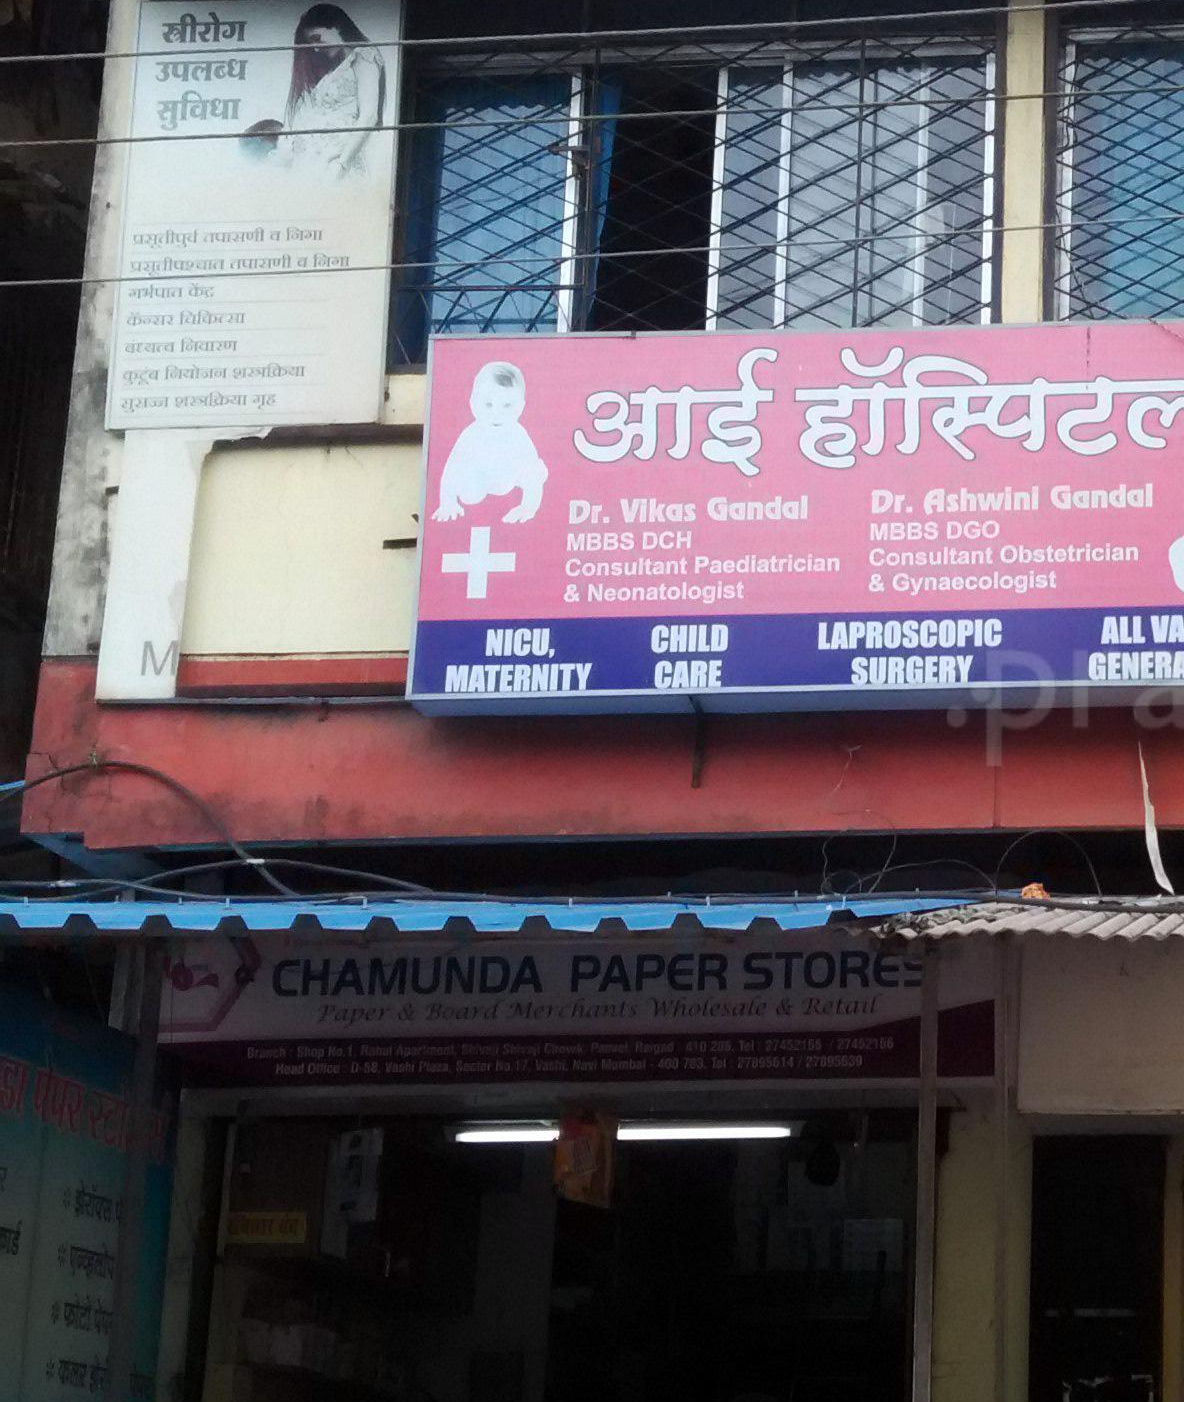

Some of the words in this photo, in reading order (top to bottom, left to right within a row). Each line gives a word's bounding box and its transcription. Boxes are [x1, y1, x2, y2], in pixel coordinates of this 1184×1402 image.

[162, 12, 247, 44] स्त्रीरोग
[156, 58, 248, 82] उपलब्ध
[157, 90, 241, 131] सुविधा
[165, 364, 227, 381] नियोजन
[573, 346, 778, 477] आई
[568, 499, 610, 525] Dr.
[620, 498, 696, 524] Vikas
[707, 495, 809, 521] Gandal
[871, 489, 913, 515] Dr.
[923, 485, 1039, 513] Ashwini
[1050, 483, 1154, 510] Gandal
[567, 531, 635, 552] MBBS
[642, 530, 692, 550] DCH
[869, 520, 939, 541] MBBS
[946, 519, 1001, 540] DGO
[565, 556, 688, 578] Consultant
[694, 554, 841, 575] Paediatrician
[868, 545, 993, 567] Consultant
[1000, 542, 1140, 565] Obstetrician
[563, 582, 580, 602] &
[587, 580, 745, 604] Neonatologist
[867, 572, 885, 593] &
[892, 569, 1057, 595] Gynaecologist
[485, 627, 555, 658] NICU,
[651, 623, 729, 653] CHILD
[817, 617, 1003, 652] LAPROSCOPIC
[1101, 613, 1146, 646] ALL
[444, 661, 592, 693] MATERNITY
[653, 659, 723, 689] CARE
[851, 653, 974, 685] SURGERY
[272, 955, 543, 998] CHAMUNDA
[570, 953, 729, 993] PAPER
[317, 1004, 389, 1029] Paper
[397, 1005, 416, 1022] &
[425, 1000, 500, 1022] Board
[507, 997, 638, 1020] Merchants
[652, 995, 767, 1018] Wholesale
[775, 999, 792, 1016] &
[803, 994, 882, 1016] Retail
